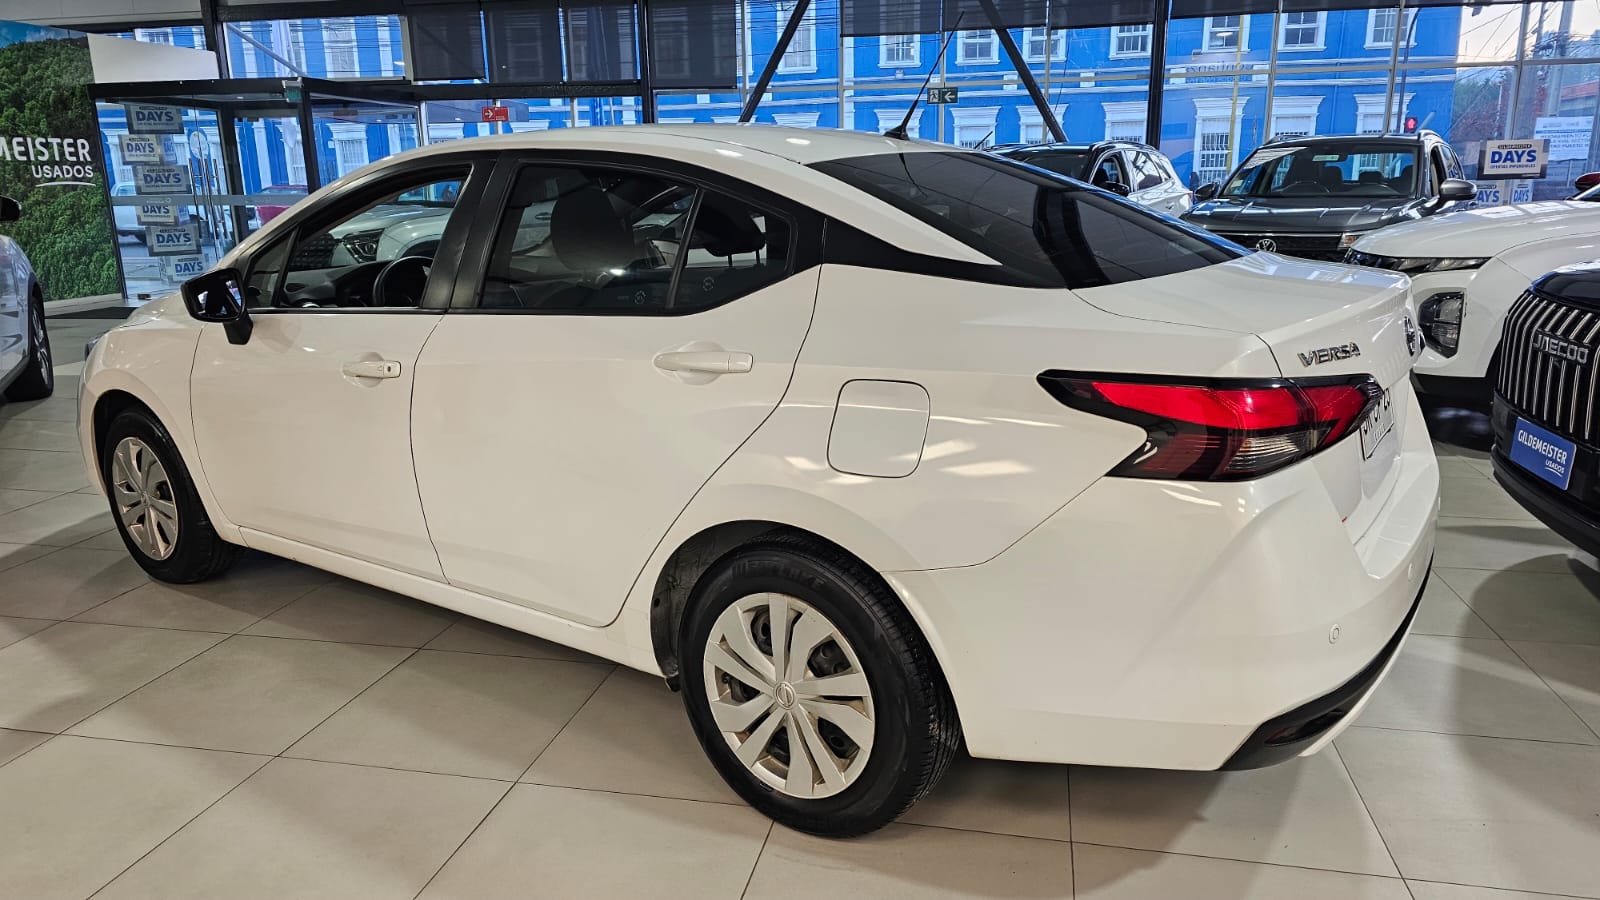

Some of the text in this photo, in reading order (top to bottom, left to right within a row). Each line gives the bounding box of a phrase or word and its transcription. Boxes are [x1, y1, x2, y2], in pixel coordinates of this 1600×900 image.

[135, 111, 174, 122] DAYS
[126, 142, 155, 153] DAYS
[1490, 150, 1536, 163] DAYS
[31, 165, 94, 178] USADOS
[143, 173, 182, 185] DAYS
[1477, 190, 1500, 203] AYS
[1513, 189, 1530, 202] DAYS
[142, 204, 170, 215] DAYS
[156, 233, 192, 244] DAYS
[175, 261, 204, 274] DAYS
[1296, 341, 1361, 367] VERSA
[1517, 428, 1568, 465] GILDEMEISTER
[1544, 459, 1565, 473] USADOS
